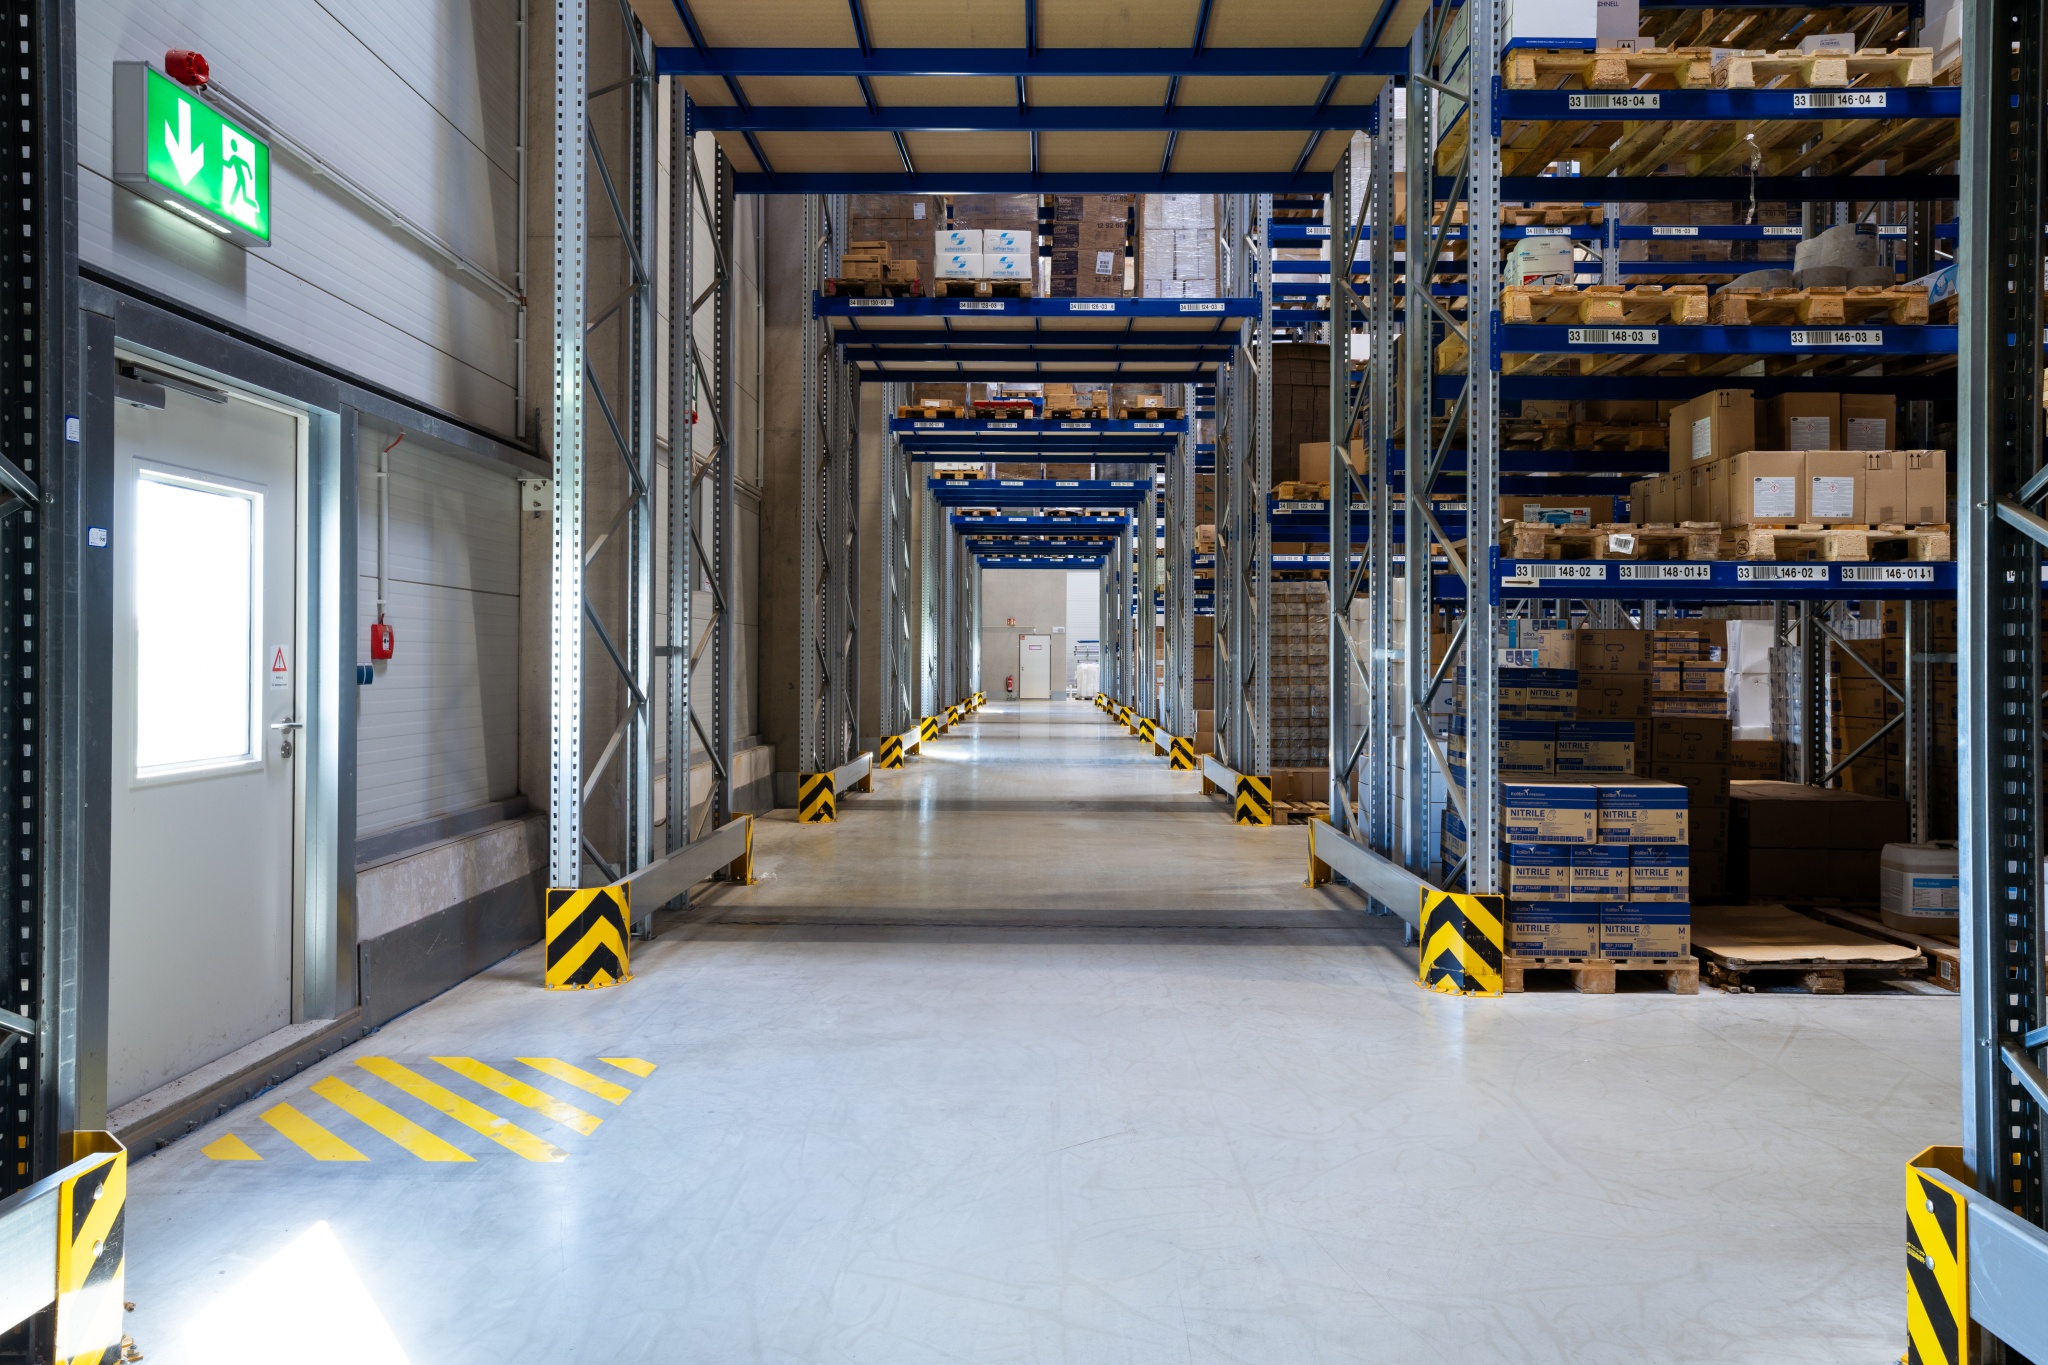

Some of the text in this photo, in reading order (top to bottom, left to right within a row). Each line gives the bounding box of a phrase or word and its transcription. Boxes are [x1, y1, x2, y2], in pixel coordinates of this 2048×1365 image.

[1570, 96, 1657, 106] 33 148-04 6
[1795, 96, 1806, 106] 33
[1838, 95, 1871, 105] 146-04
[1569, 331, 1656, 342] 33 148-03 9
[1792, 332, 1880, 342] 33 146-03 5
[1517, 566, 1604, 577] 33 148-02 2
[1620, 566, 1708, 577] 33 148-01 5
[1739, 568, 1826, 578] 33 146-02 8
[1843, 569, 1931, 579] 33 146-01 1
